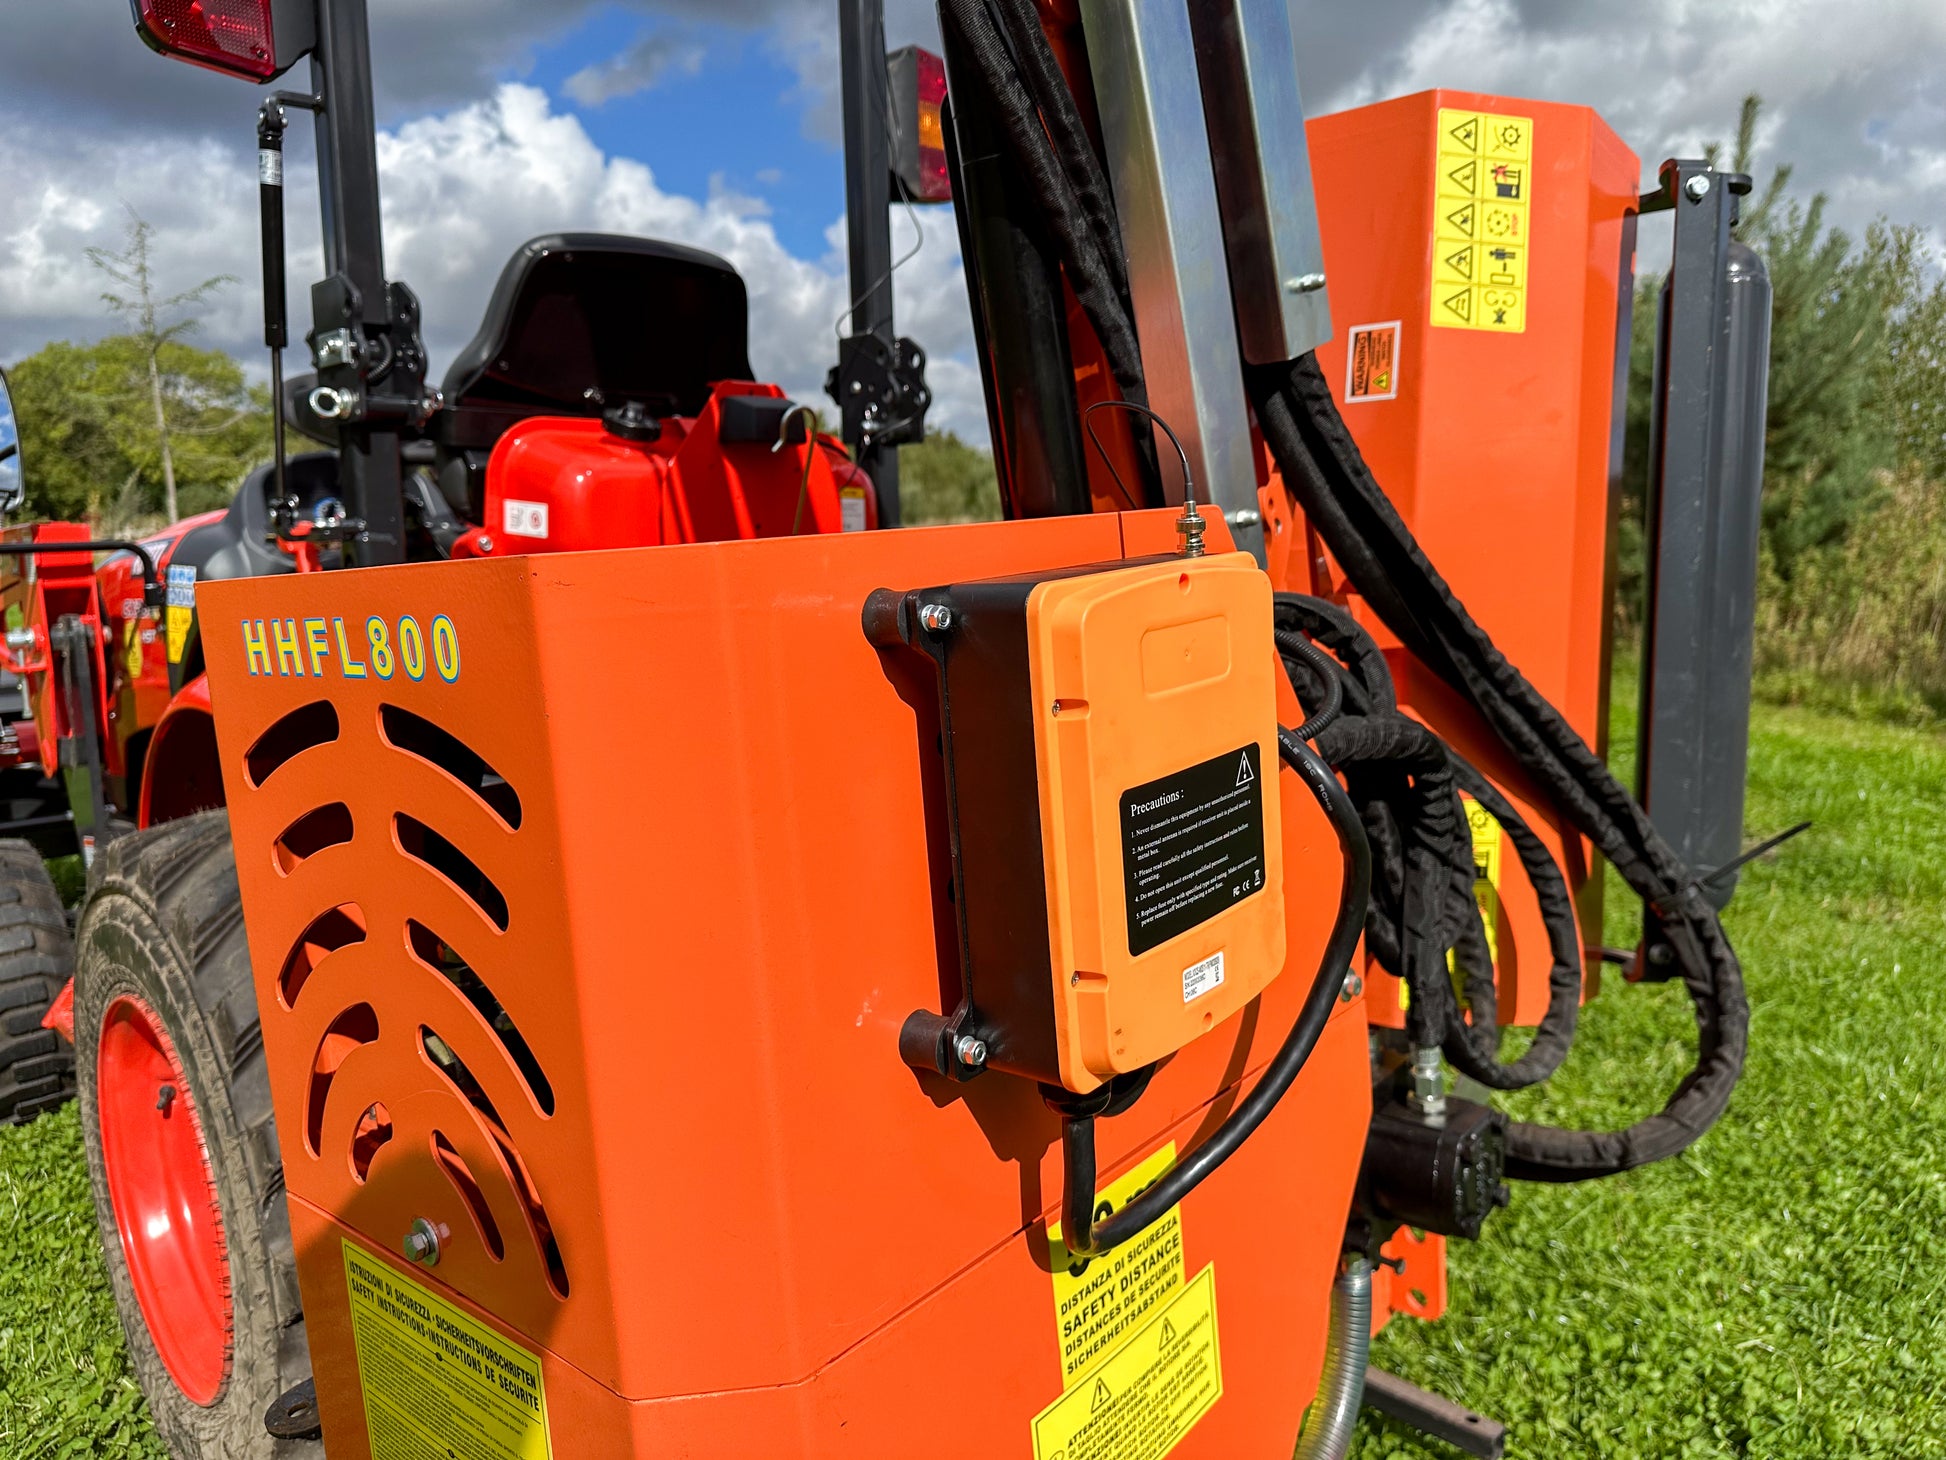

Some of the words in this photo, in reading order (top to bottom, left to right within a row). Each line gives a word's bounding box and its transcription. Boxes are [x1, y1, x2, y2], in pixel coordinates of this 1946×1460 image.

[1356, 336, 1366, 390] WARNING
[242, 614, 460, 684] HHFL800
[1278, 734, 1300, 755] ABLE
[1136, 827, 1149, 836] Never
[1179, 807, 1198, 819] equipment
[1144, 837, 1161, 849] external
[1162, 832, 1177, 842] antenna
[1182, 822, 1197, 834] required
[1138, 850, 1149, 860] metal
[1139, 867, 1152, 877] Please
[1153, 862, 1162, 870] read
[1163, 855, 1180, 866] carefully
[1193, 845, 1203, 853] safety
[1182, 871, 1194, 881] except
[1141, 906, 1157, 917] Replace
[1061, 1269, 1112, 1315] DISTANZA
[1114, 1257, 1124, 1272] DI
[1127, 1216, 1177, 1262] SICUREZZA
[1064, 1284, 1115, 1338] SAFETY
[1120, 1232, 1179, 1292] DISTANCE
[350, 1259, 384, 1292] ISTRUZIONI
[386, 1282, 392, 1298] DI
[394, 1288, 432, 1322] SICUREZZA
[436, 1314, 536, 1390] SICHERHEITSVORSCHRIFTEN
[1066, 1303, 1121, 1356] DISTANCES
[1124, 1290, 1136, 1307] DE
[1139, 1252, 1180, 1295] SECURITE
[1067, 1273, 1178, 1375] SICHERHEITSABSTAND
[352, 1278, 374, 1303] SAFETY
[484, 1365, 496, 1384] DE
[499, 1374, 540, 1412] SECURITE
